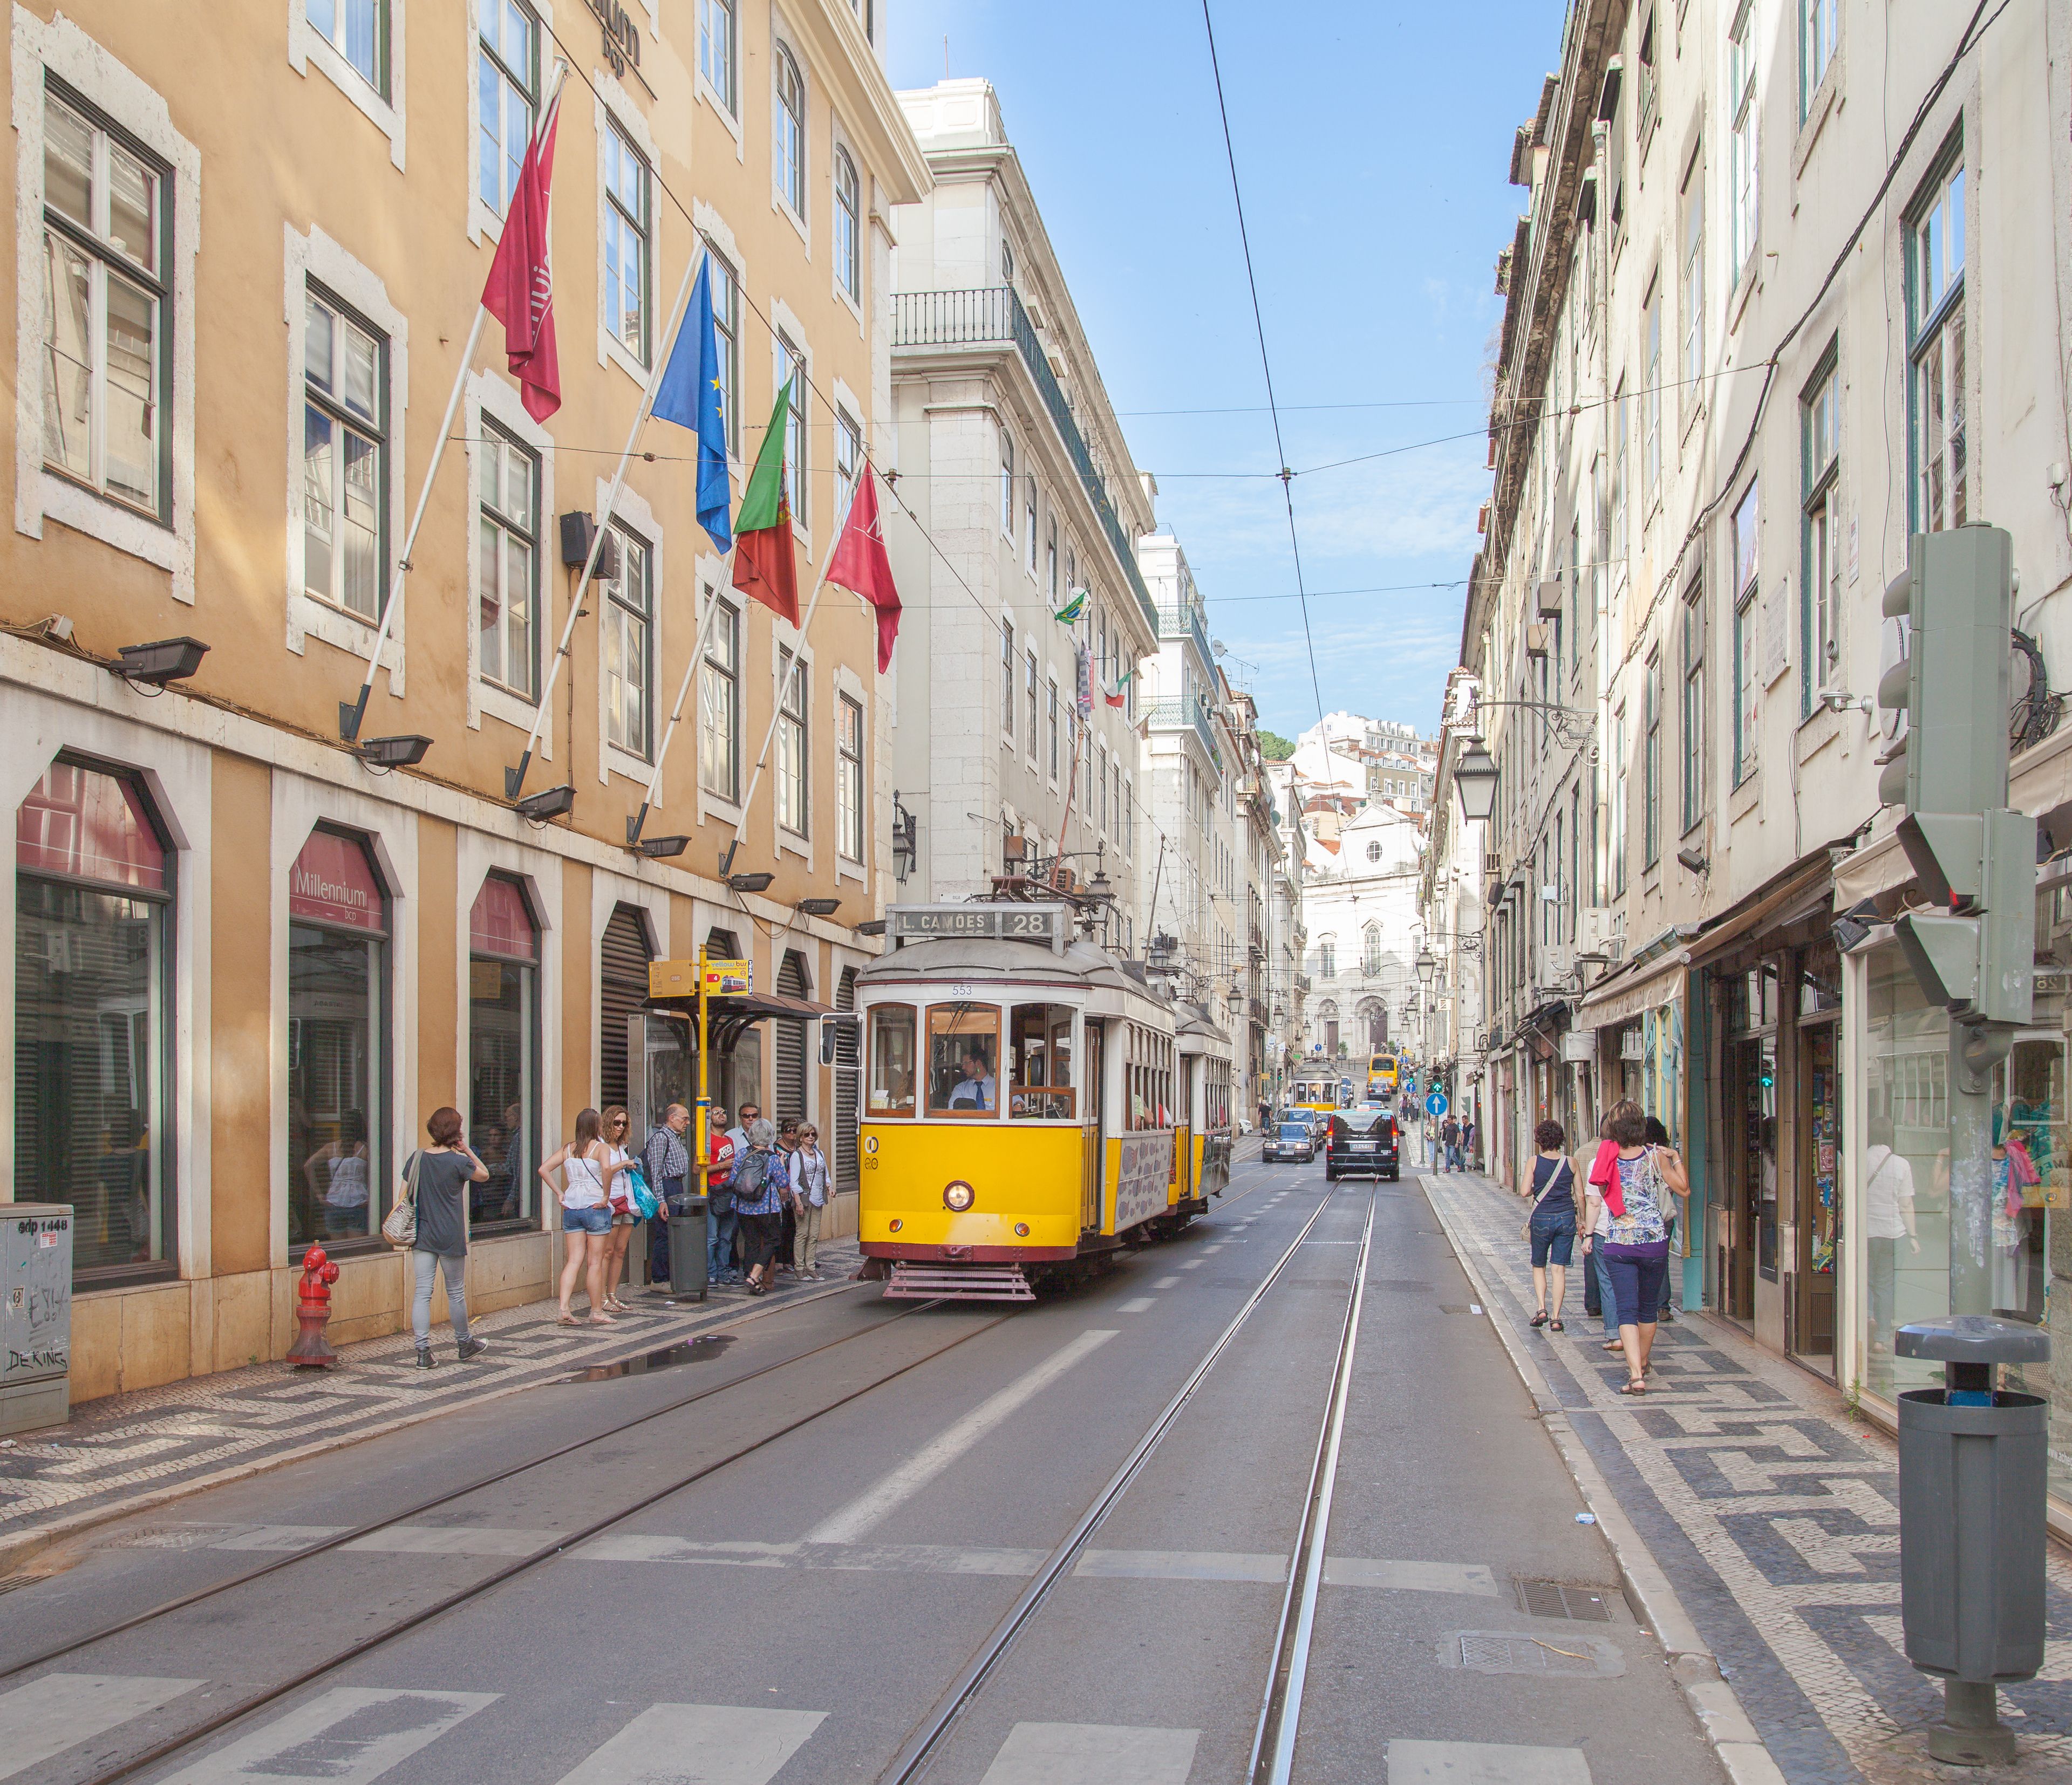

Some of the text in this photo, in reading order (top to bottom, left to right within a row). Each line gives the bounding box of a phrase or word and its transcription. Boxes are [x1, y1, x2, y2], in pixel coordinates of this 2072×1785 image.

[296, 864, 366, 907] Millennium
[345, 907, 357, 923] bcp
[903, 914, 1044, 934] L. CAMÕES 28
[952, 985, 972, 996] 553
[18, 1218, 69, 1236] edp 1448
